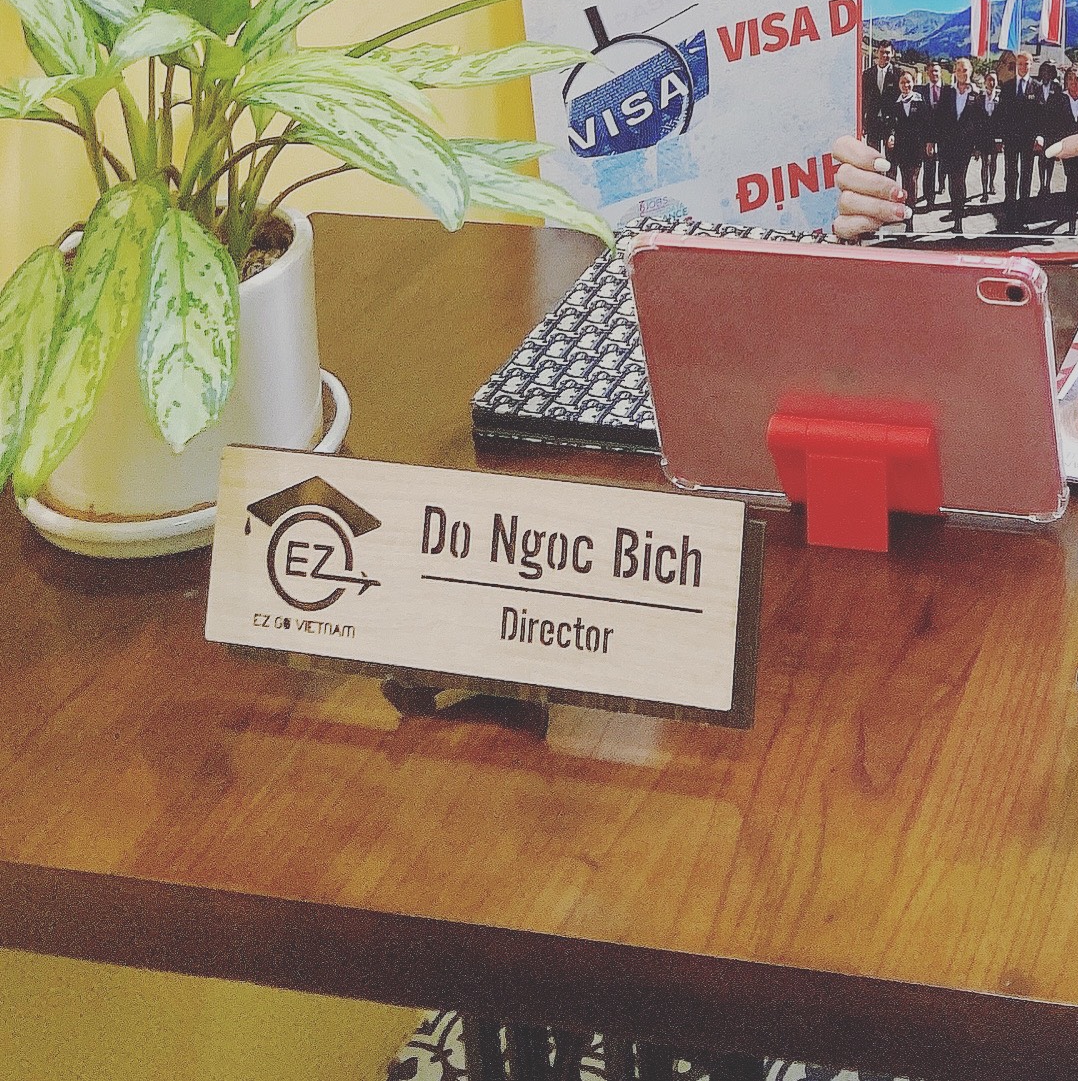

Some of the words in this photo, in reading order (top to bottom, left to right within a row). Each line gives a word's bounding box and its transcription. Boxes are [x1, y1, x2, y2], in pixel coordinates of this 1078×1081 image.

[716, 5, 821, 62] VISA
[568, 70, 689, 151] VISA
[285, 542, 348, 578] EZ
[422, 505, 471, 558] Do
[490, 514, 593, 579] Ngoc
[613, 527, 702, 588] Bich
[253, 613, 270, 627] EZ
[501, 606, 613, 654] Director
